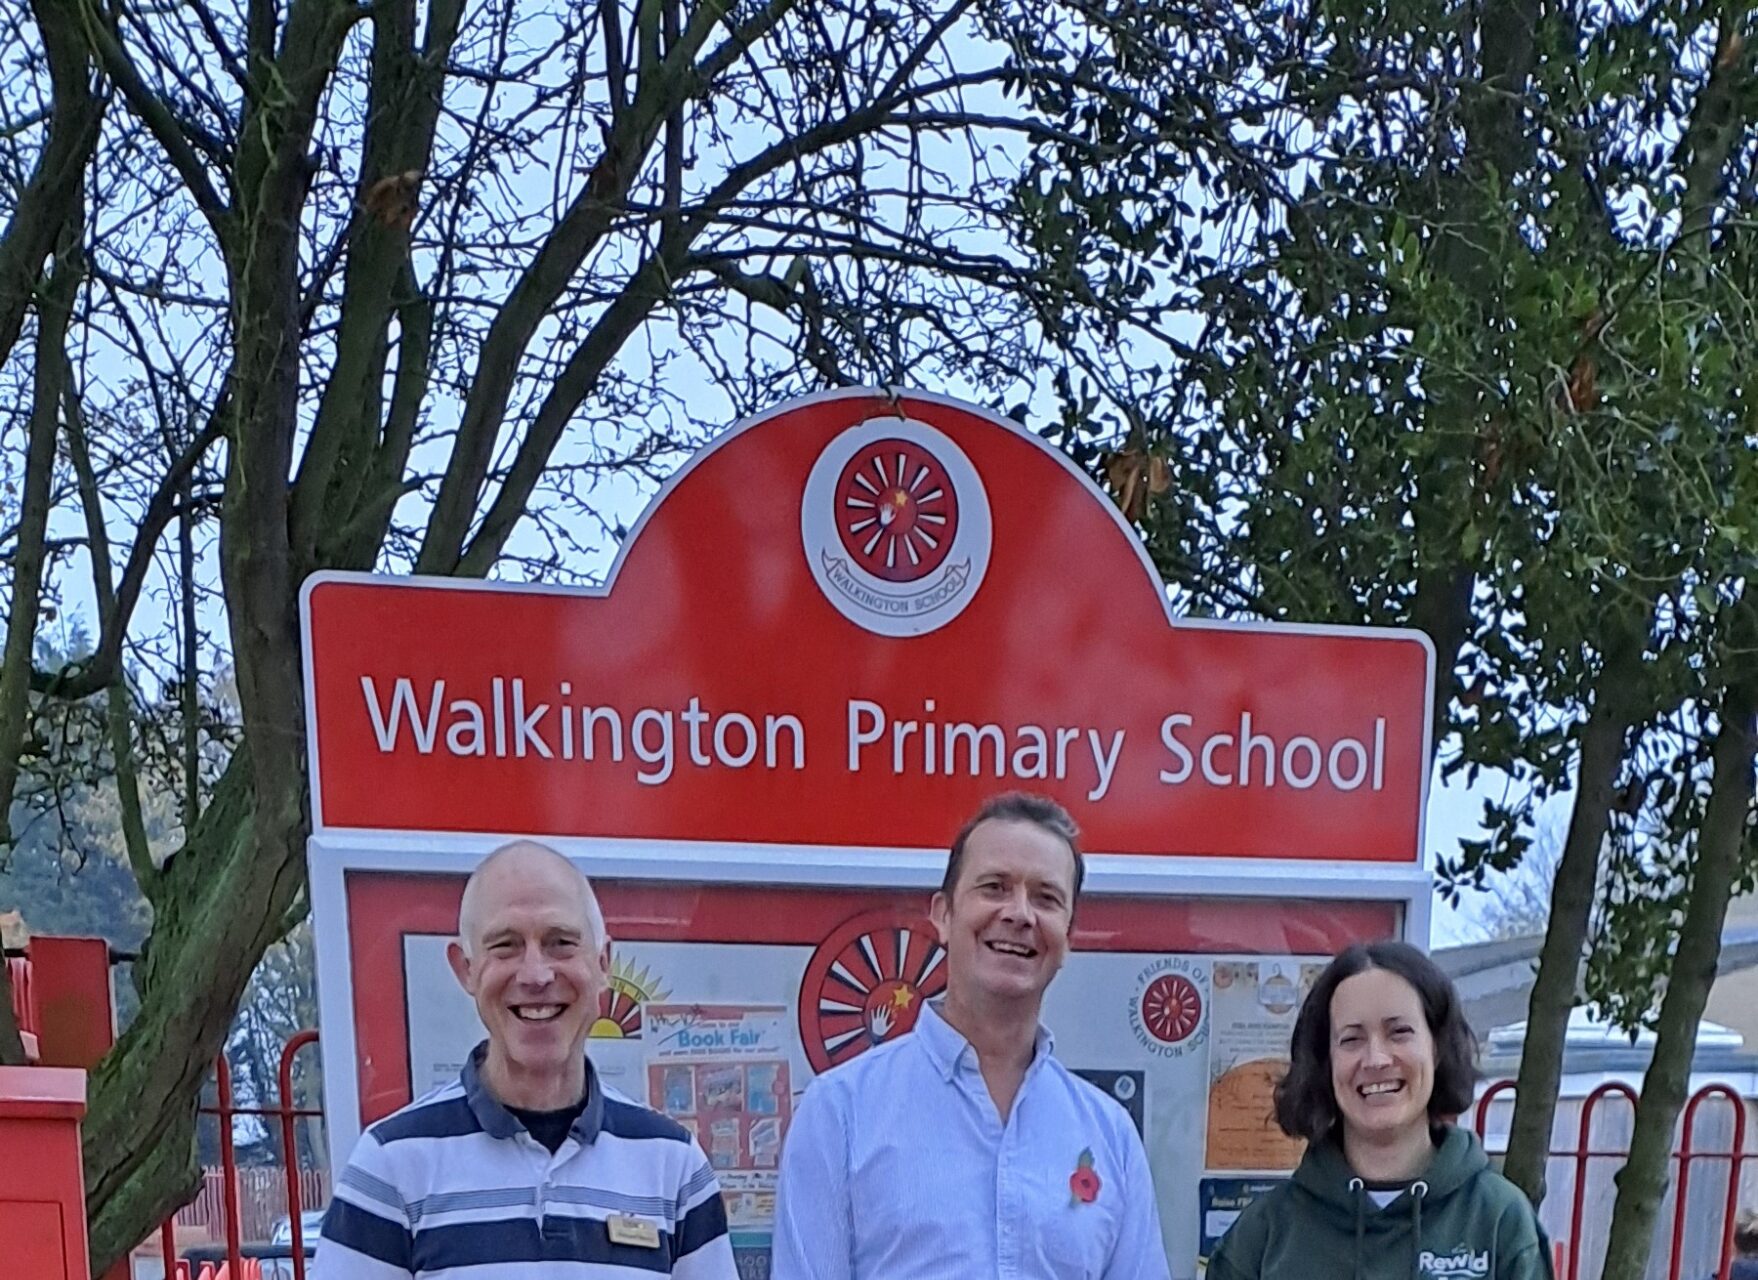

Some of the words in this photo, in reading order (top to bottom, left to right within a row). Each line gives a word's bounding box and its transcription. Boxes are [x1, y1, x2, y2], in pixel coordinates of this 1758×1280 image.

[833, 567, 909, 613] WALKINGTON
[915, 576, 962, 611] SCHOOL
[360, 675, 806, 786] Walkington
[847, 698, 1126, 801] Primary
[1159, 711, 1386, 791] School
[1138, 958, 1190, 984] FRIENDS
[1192, 967, 1210, 983] OF
[678, 1029, 724, 1047] Book
[731, 1028, 761, 1046] Fair
[1128, 996, 1183, 1058] WALKINGTON
